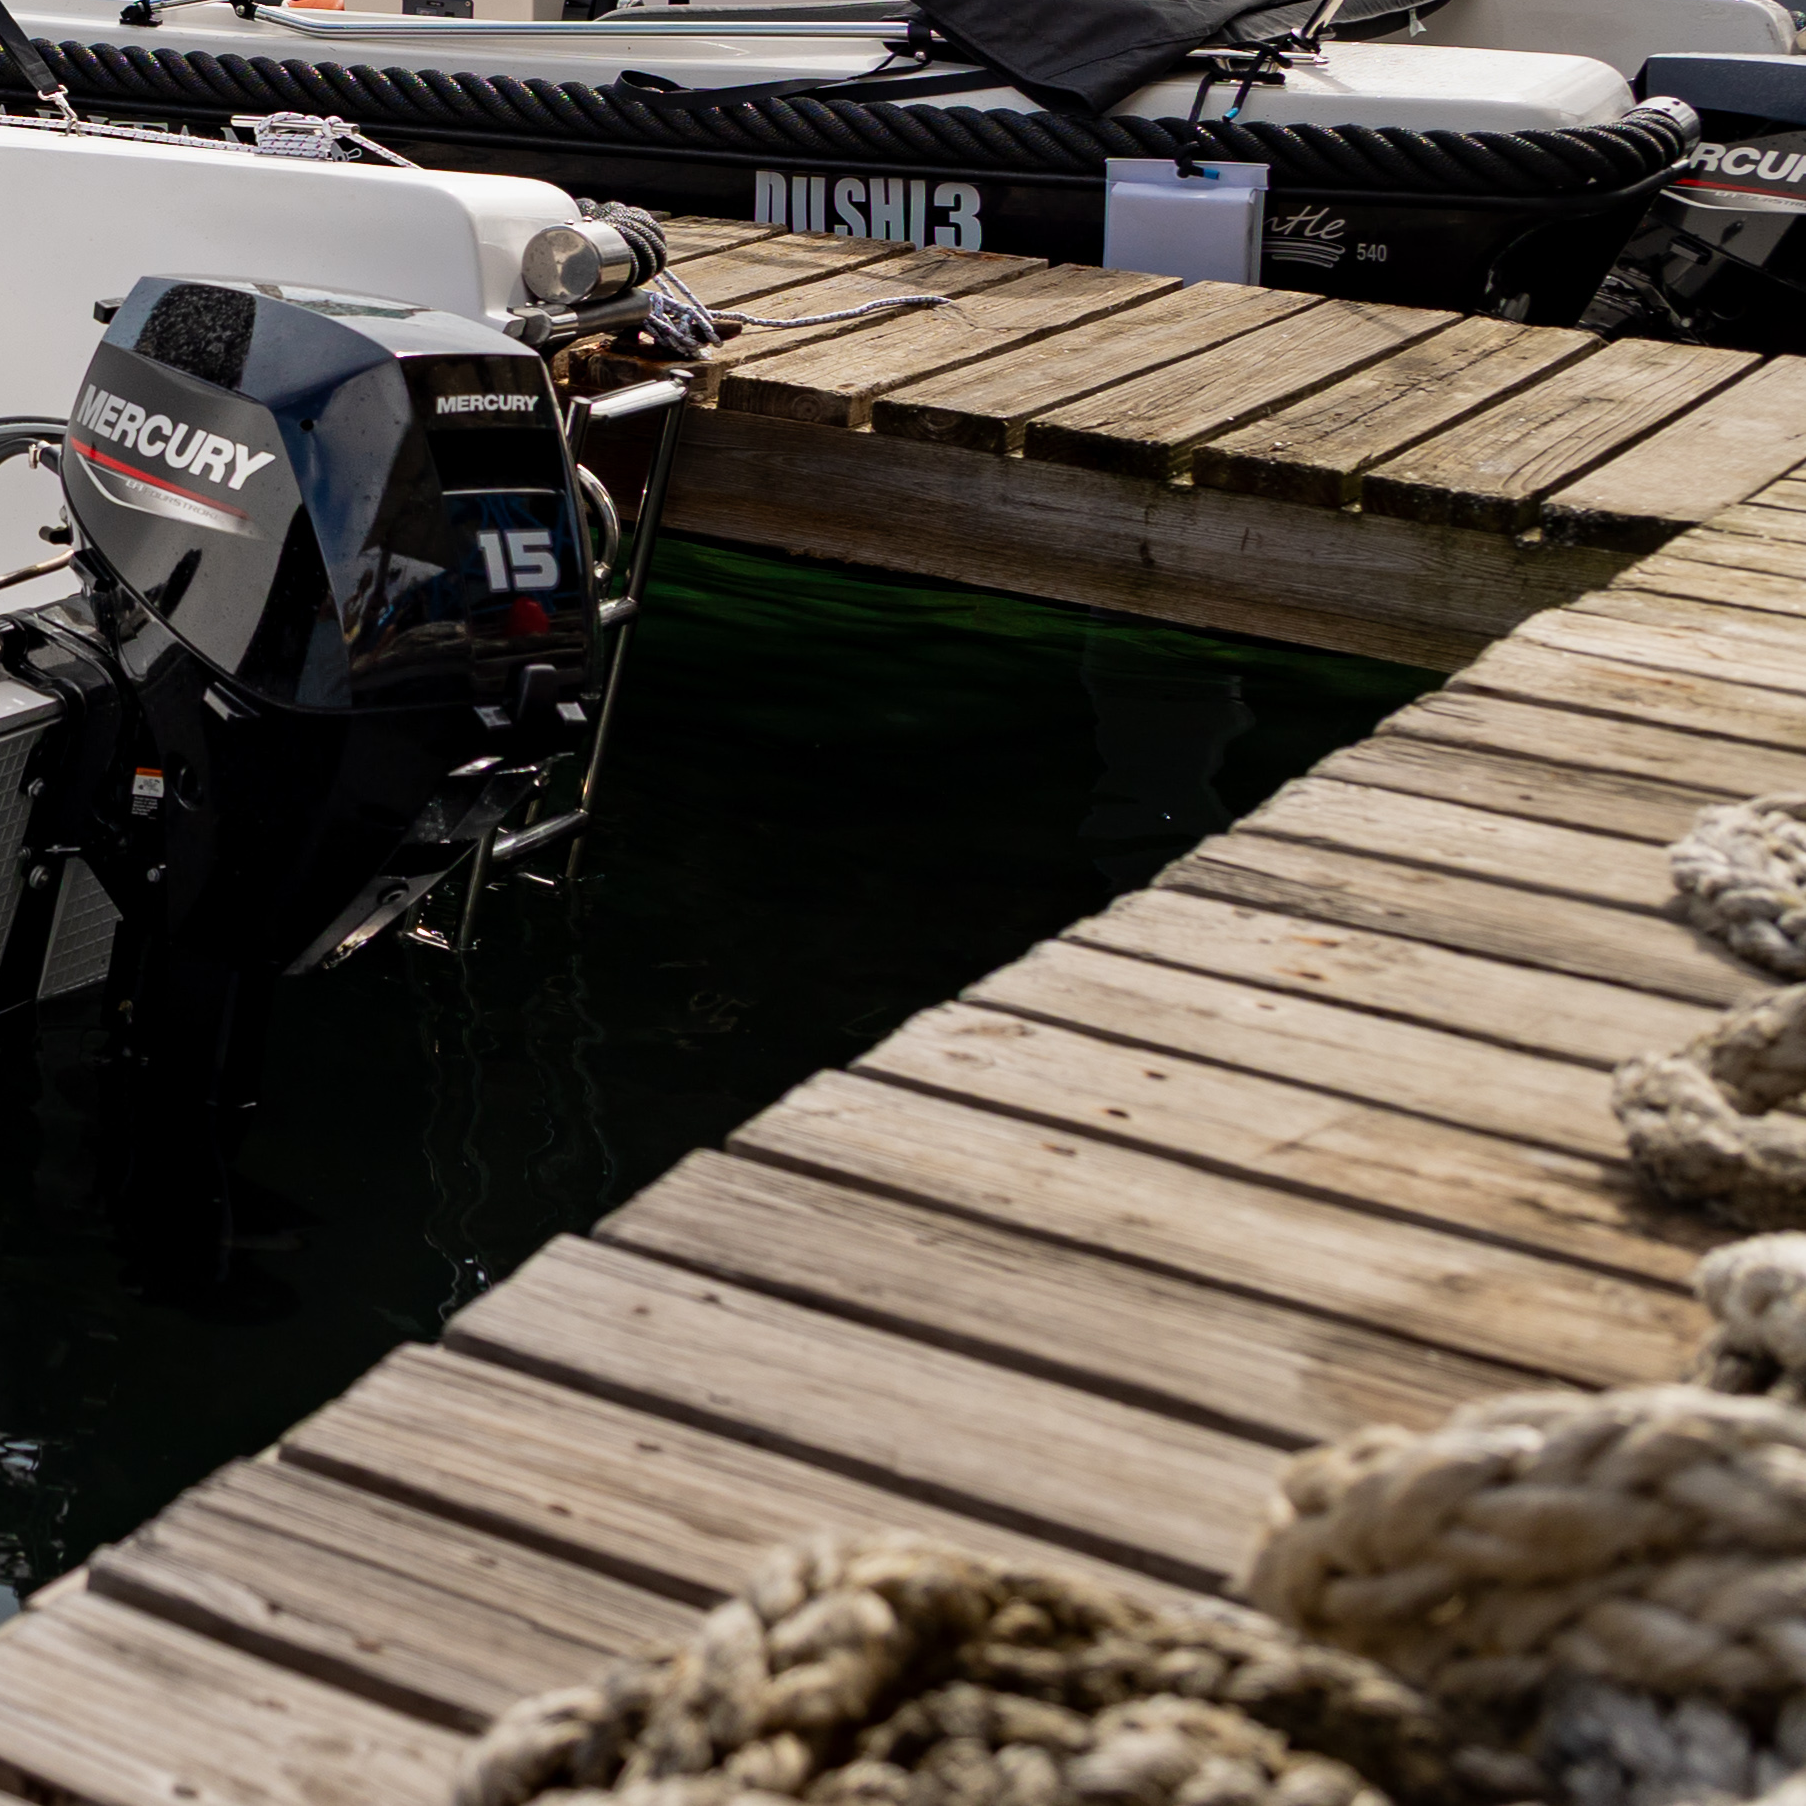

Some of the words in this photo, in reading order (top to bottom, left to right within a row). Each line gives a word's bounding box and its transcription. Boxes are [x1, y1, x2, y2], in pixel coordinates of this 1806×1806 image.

[934, 182, 982, 252] 3
[1263, 205, 1346, 240] ntle
[1356, 243, 1388, 262] 540
[436, 394, 539, 414] MERCURY
[76, 383, 276, 491] MERCURY
[476, 528, 560, 593] 15
